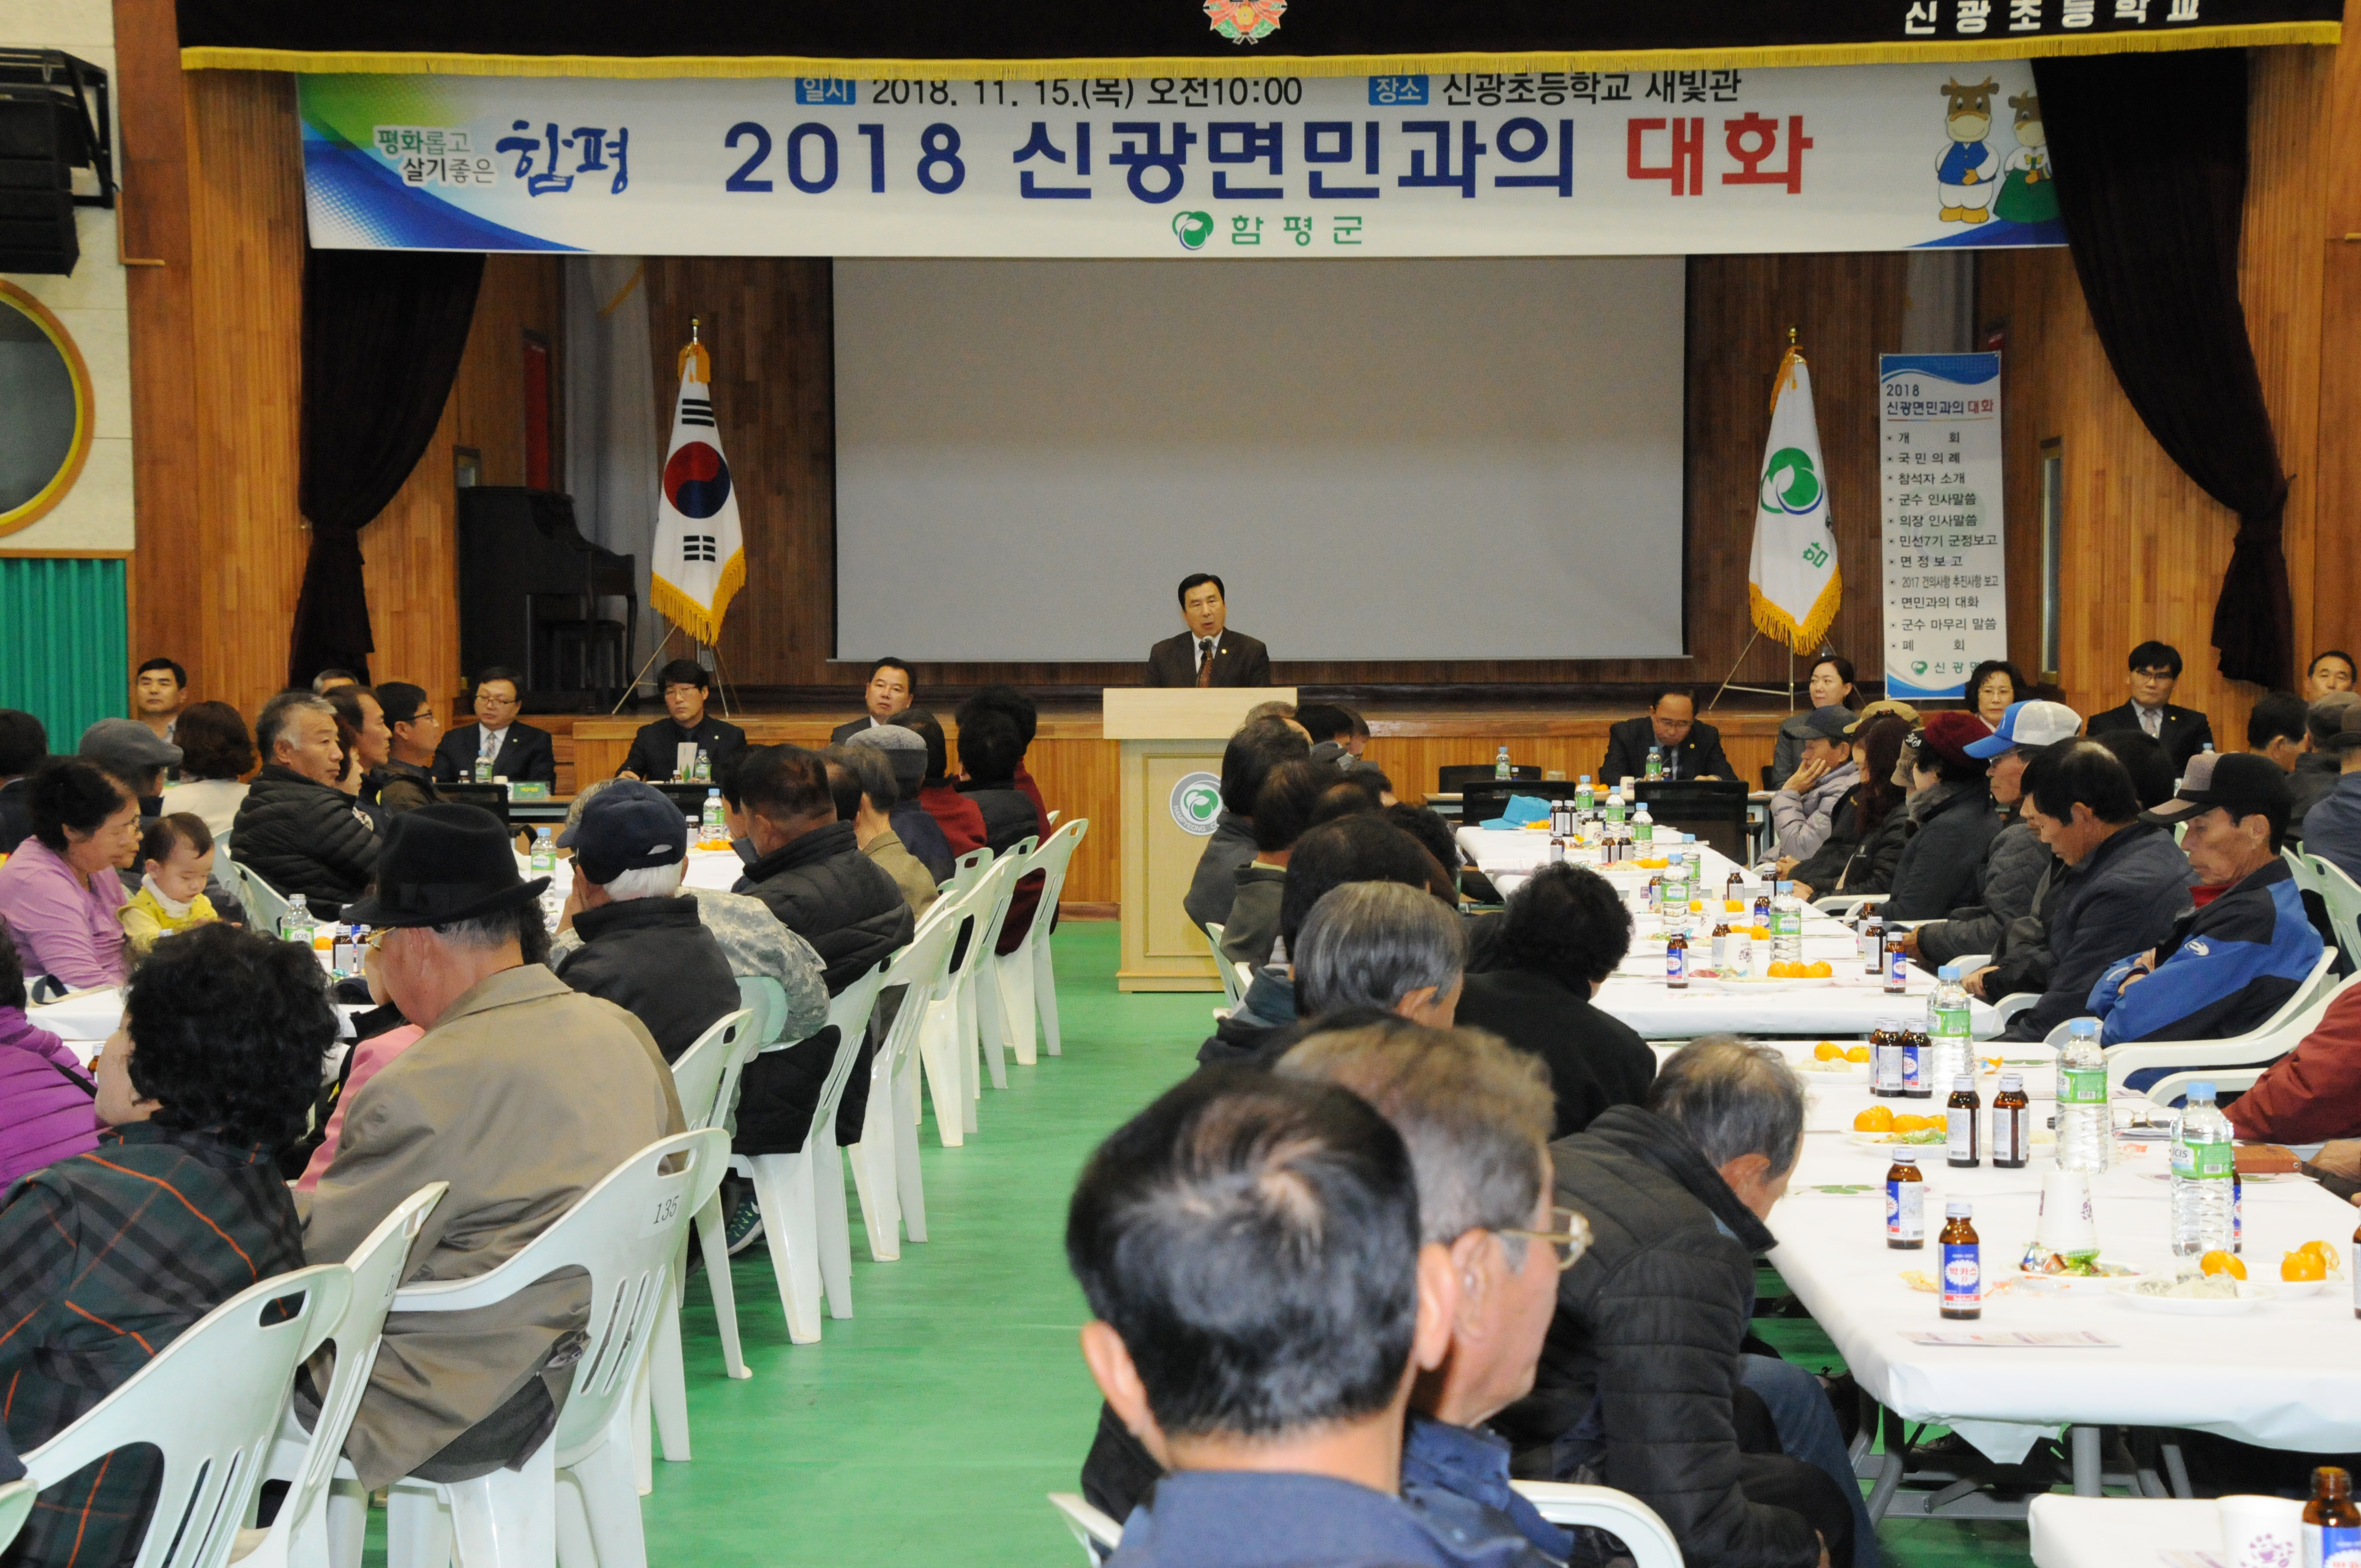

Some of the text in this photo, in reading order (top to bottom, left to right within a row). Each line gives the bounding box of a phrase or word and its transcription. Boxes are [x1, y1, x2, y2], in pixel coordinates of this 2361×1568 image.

[1376, 78, 1422, 102] 장소
[1443, 71, 1633, 106] 신광초등학교
[1645, 70, 1742, 103] 새빛관
[378, 129, 471, 155] 평화롭고
[496, 119, 629, 197] 함평
[724, 112, 1813, 204] 2018 신광면민과의 대화
[402, 157, 494, 184] 살기좋은
[1231, 215, 1363, 246] 함평군
[1886, 384, 1920, 396] 2018
[1886, 399, 1994, 416] 신광면민과의 대화
[1898, 472, 1965, 485] 참석자 소개
[1898, 493, 1977, 505] 군수 인사말씀
[1900, 514, 1977, 527] 의장 인사말씀
[1900, 535, 1998, 547] 민선7기 군정보고
[1902, 575, 1999, 589] 2017 건의사항 추진사항 보고
[1901, 596, 1979, 609] 면민과의 대화
[1902, 617, 1997, 631] 군수 마무리 말씀
[1173, 805, 1206, 832] HAMPYEONG
[2172, 1146, 2188, 1158] ICIS
[653, 1195, 680, 1224] 135
[1950, 1267, 1977, 1276] 박카스
